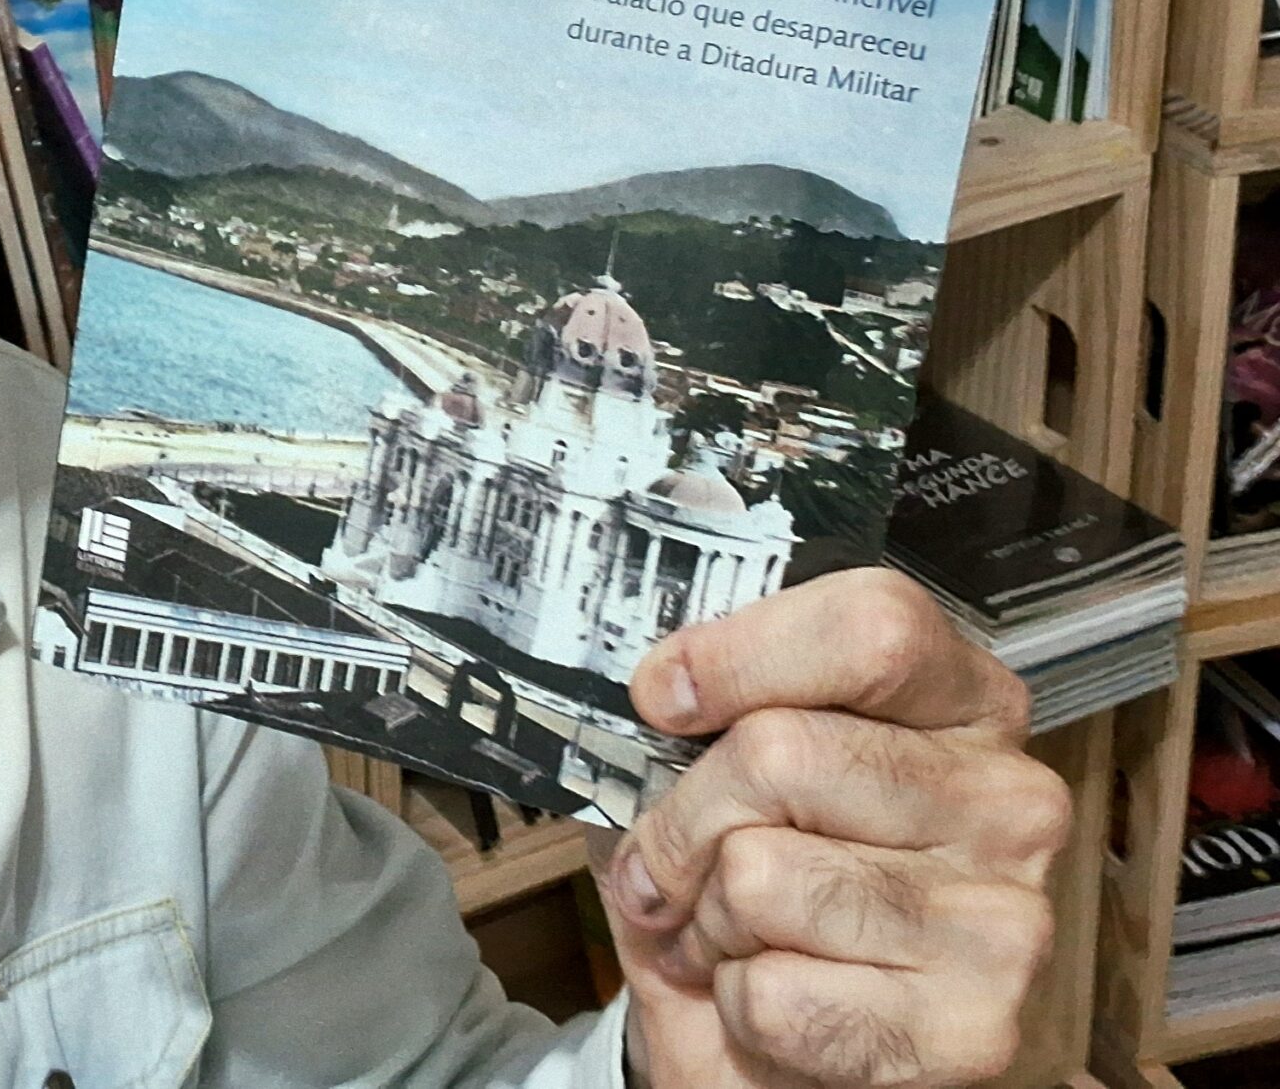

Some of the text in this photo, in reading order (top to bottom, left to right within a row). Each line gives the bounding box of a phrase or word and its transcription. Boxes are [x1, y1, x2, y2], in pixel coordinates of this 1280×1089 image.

[566, 16, 921, 105] durante a Ditadura Militar
[693, 2, 745, 28] que
[752, 8, 927, 62] desapareceu
[921, 458, 1030, 509] HANCE
